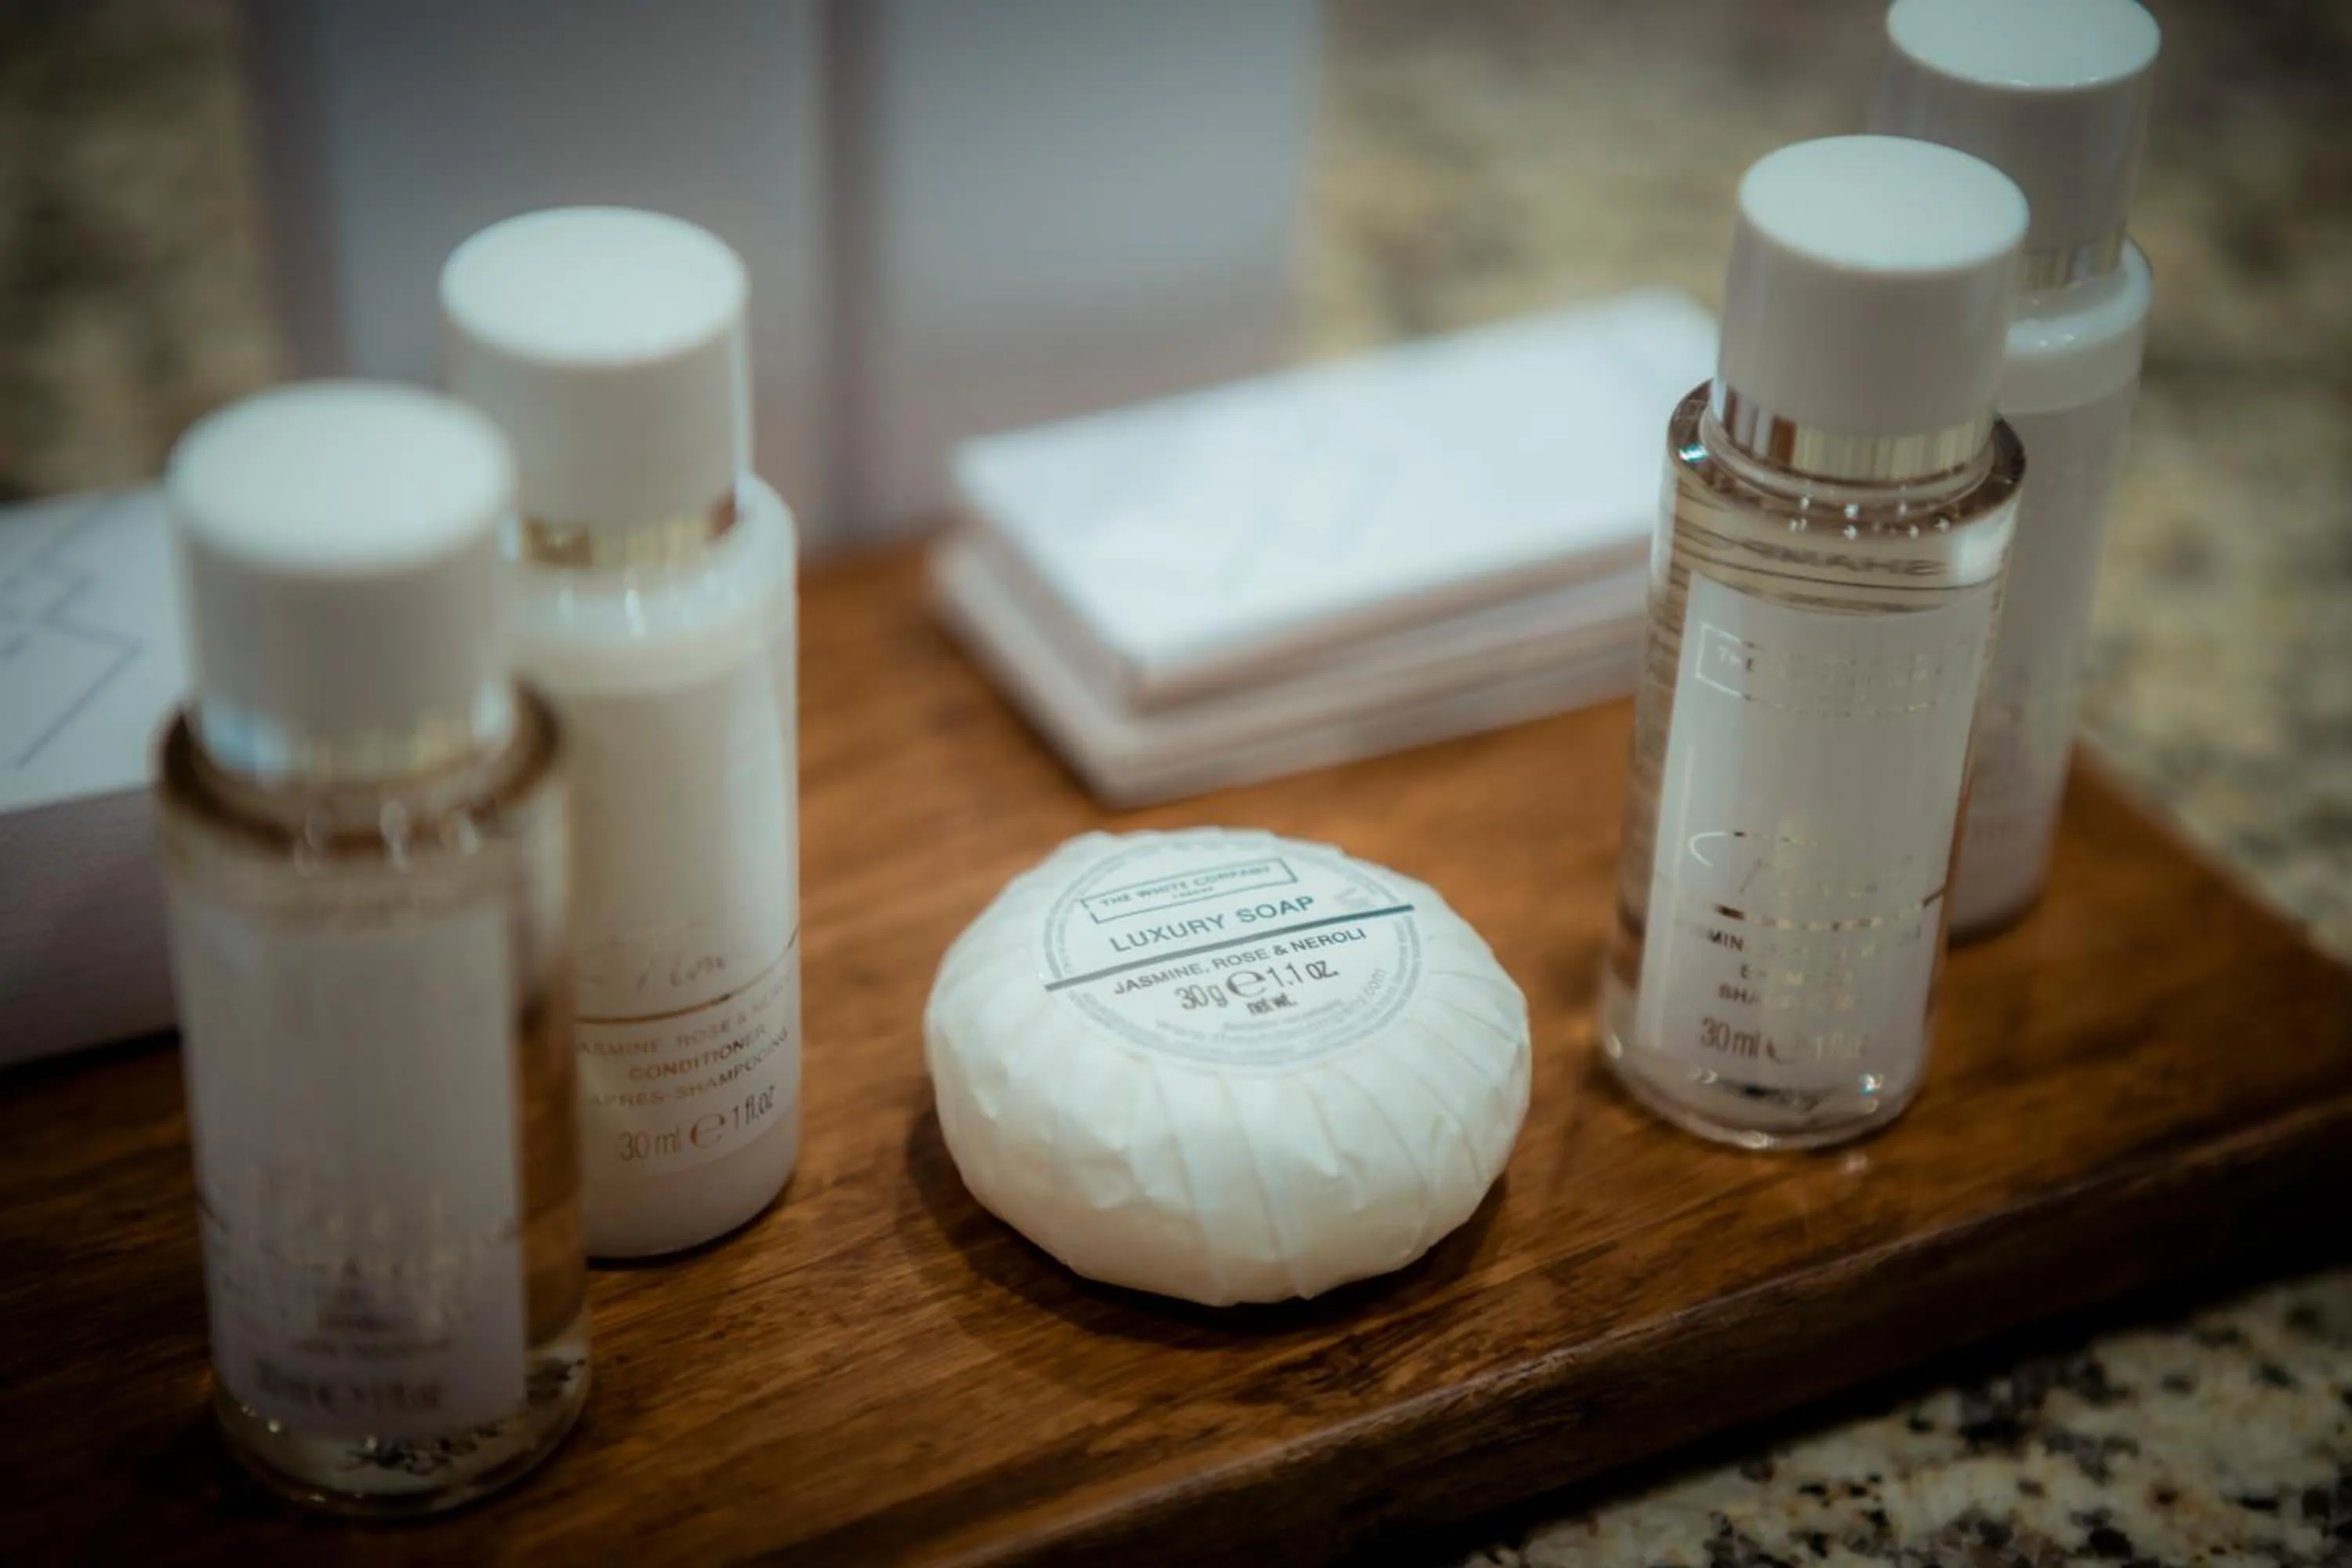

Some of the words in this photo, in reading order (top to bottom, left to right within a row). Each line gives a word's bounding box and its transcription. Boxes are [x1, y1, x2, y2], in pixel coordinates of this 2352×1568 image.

[1100, 893, 1131, 907] THE
[1135, 881, 1187, 898] WHITE
[1192, 865, 1271, 887] COMPANY
[1109, 913, 1225, 953] LUXURY
[1236, 895, 1315, 924] SOAP
[1113, 962, 1209, 995] JASMINE,
[1211, 949, 1269, 970] ROSE
[1272, 944, 1288, 956] &
[1290, 927, 1367, 953] NEROLI
[1174, 984, 1229, 1011] 30g
[1267, 962, 1304, 988] 1.1
[629, 1022, 766, 1083] CONDITIONER
